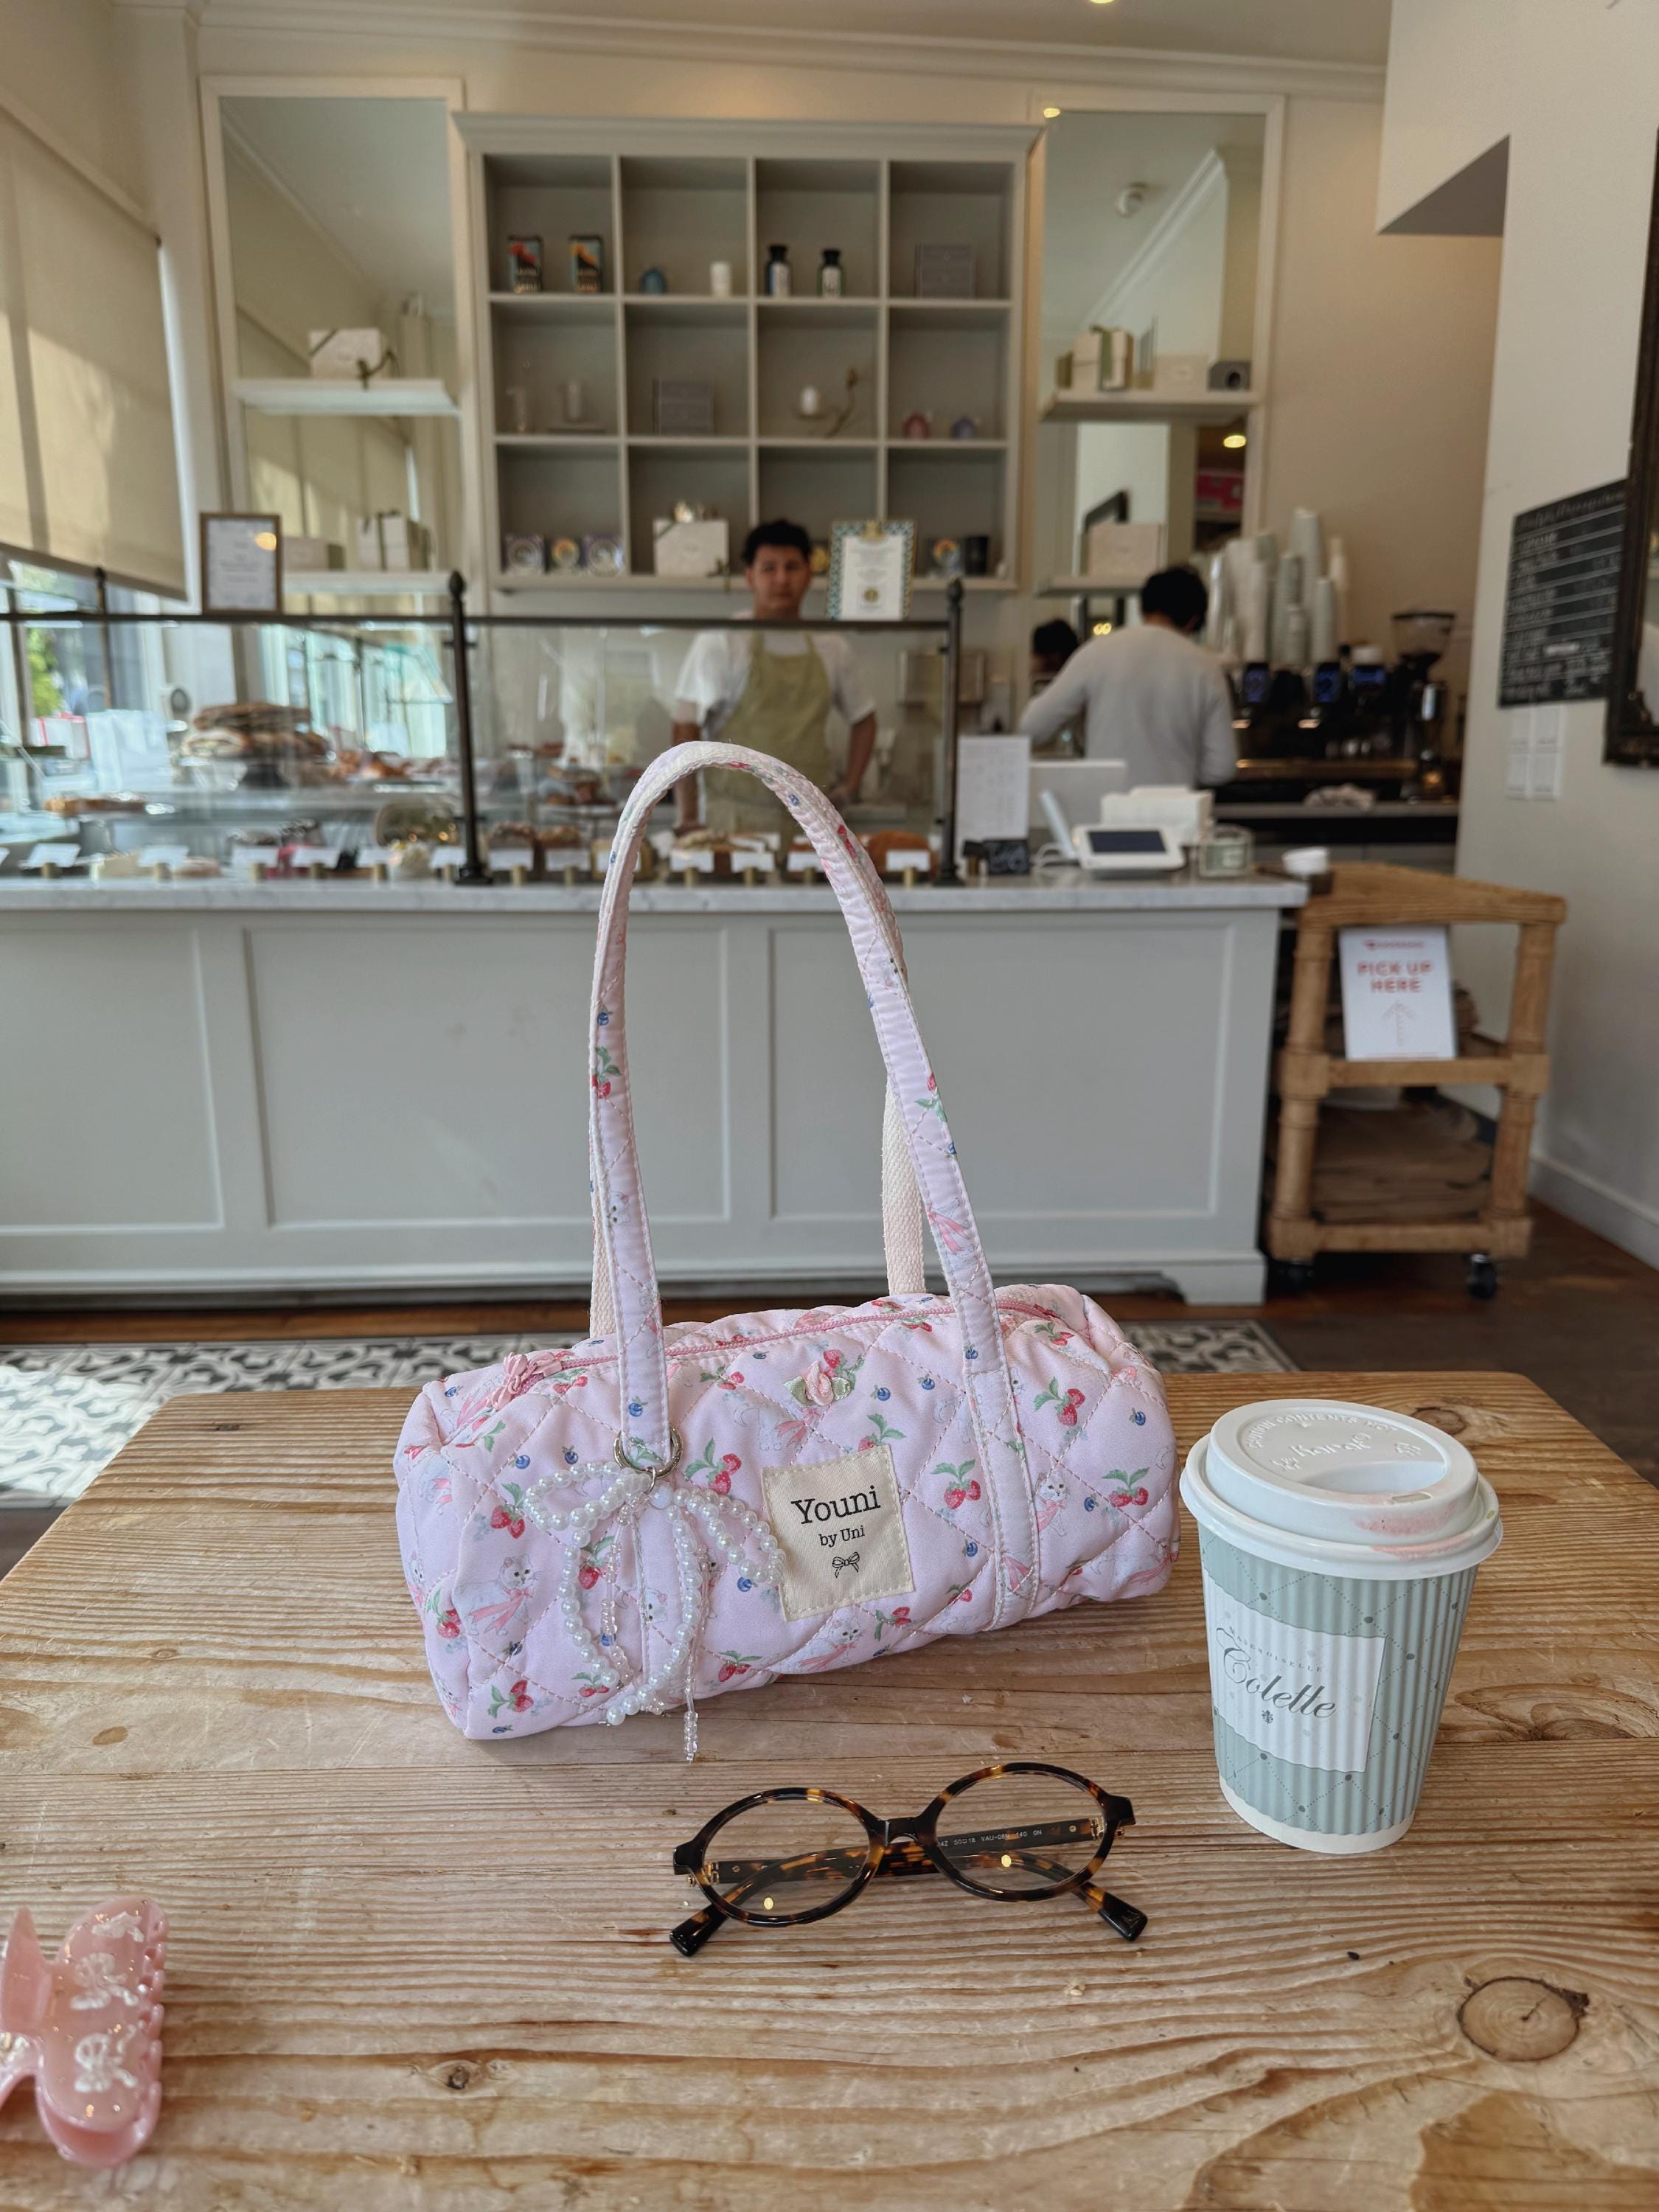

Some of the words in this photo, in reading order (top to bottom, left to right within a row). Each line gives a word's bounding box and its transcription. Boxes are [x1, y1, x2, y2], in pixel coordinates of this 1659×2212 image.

[1357, 961, 1400, 976] PICK
[1407, 960, 1433, 975] UP
[1371, 978, 1422, 992] HERE
[790, 1485, 881, 1525] Youni
[818, 1533, 838, 1548] by
[840, 1525, 866, 1542] Uni
[1216, 1627, 1337, 1718] Colette
